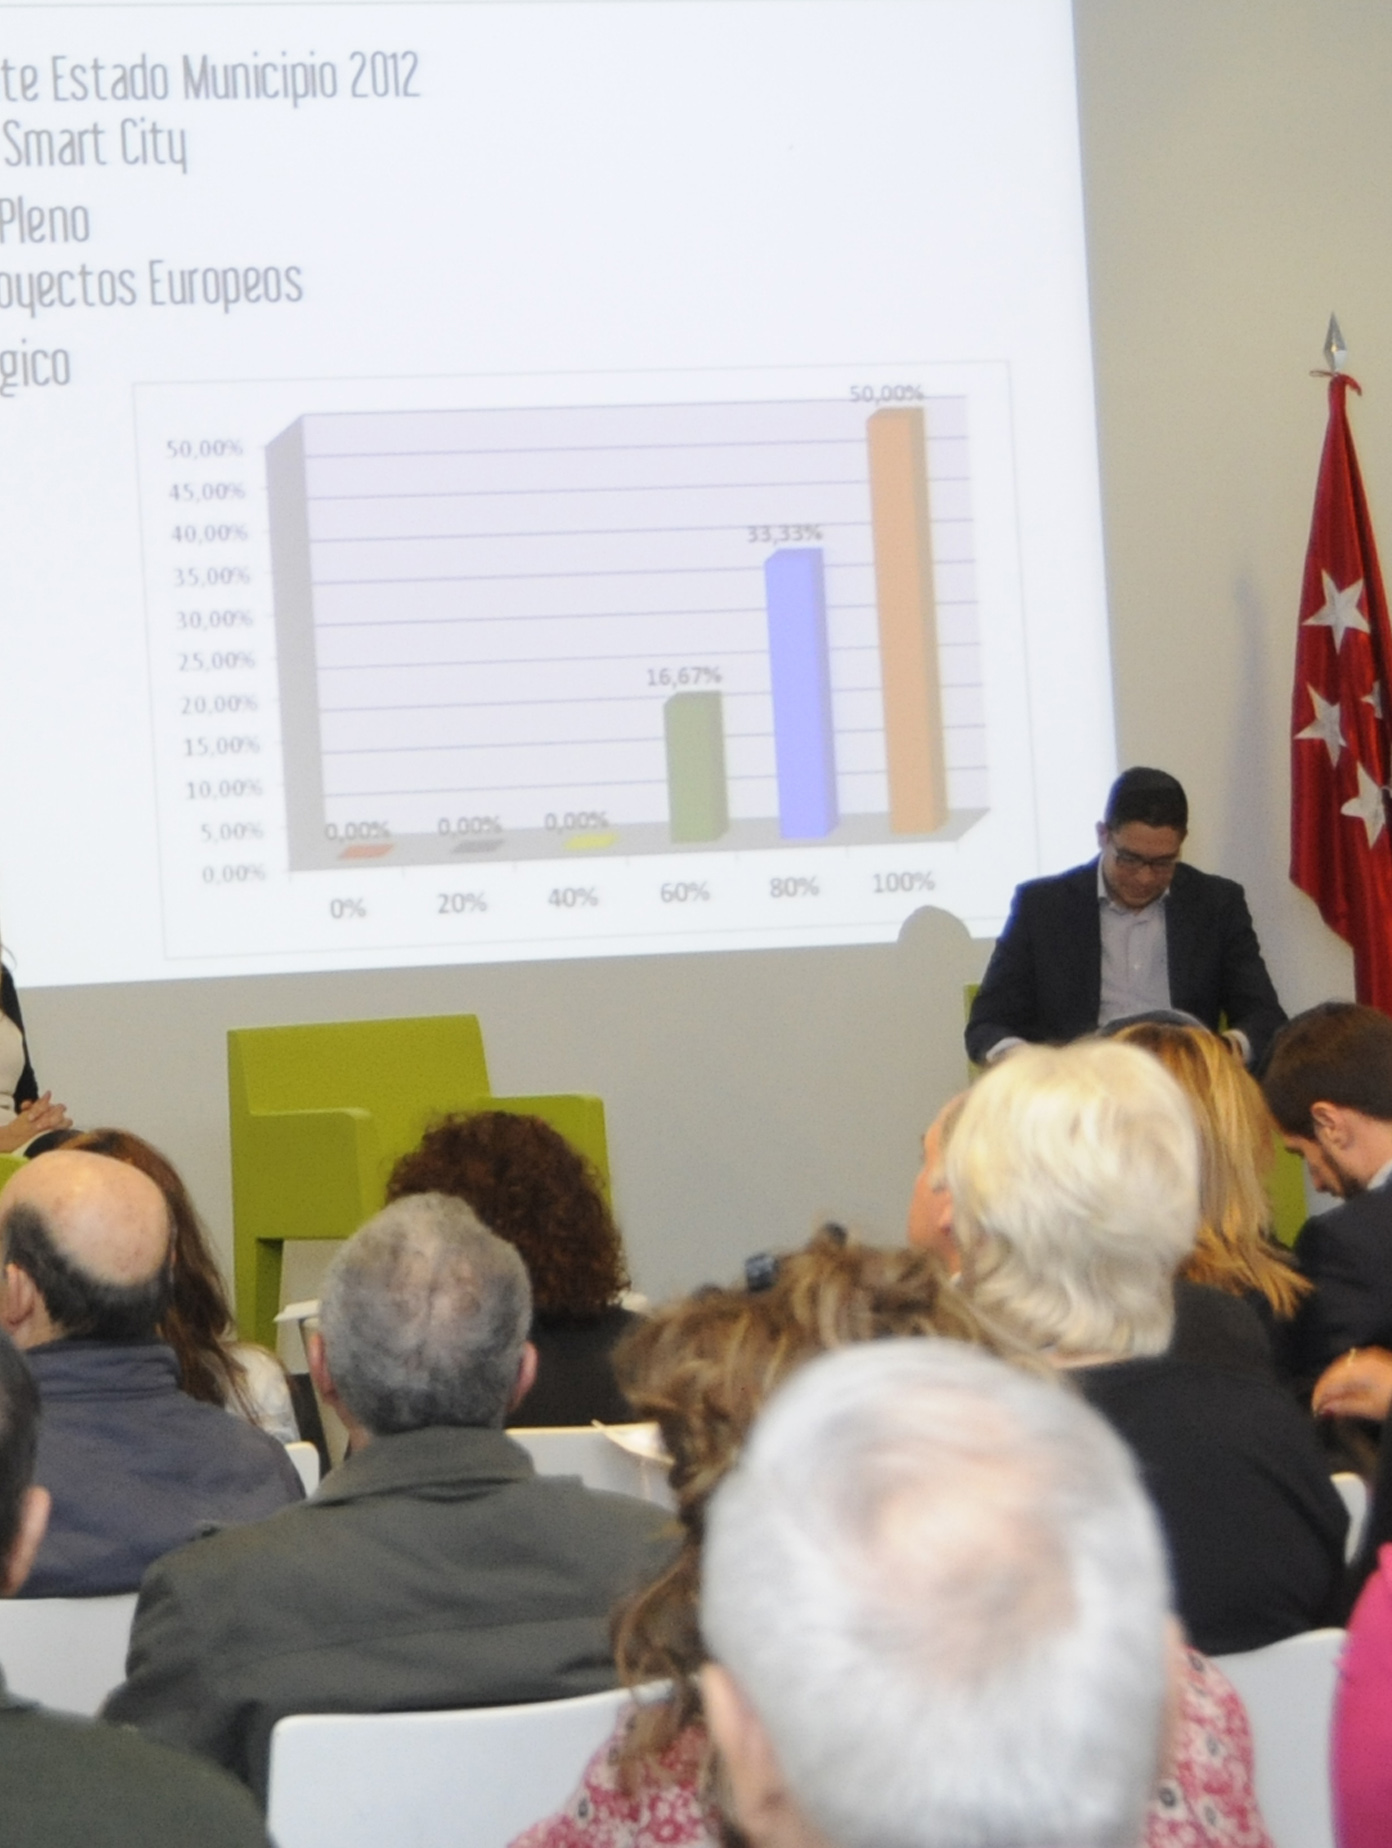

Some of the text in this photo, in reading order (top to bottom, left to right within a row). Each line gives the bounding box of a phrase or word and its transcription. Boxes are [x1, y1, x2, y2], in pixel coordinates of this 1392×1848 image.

[52, 52, 170, 102] Estado
[182, 50, 338, 109] Municipio
[350, 50, 421, 99] 2012
[2, 119, 108, 168] Smart
[120, 116, 188, 174] City
[148, 259, 304, 314] Europeos
[849, 385, 925, 405] 50,00%
[166, 438, 244, 460] 50,00%
[169, 481, 246, 503] 45,00%
[171, 524, 249, 545] 40,00%
[747, 524, 824, 544] 33,33%
[174, 566, 251, 588] 35,00%
[176, 610, 253, 631] 30,00%
[178, 652, 256, 673] 25,00%
[648, 667, 723, 688] 16,67%
[181, 695, 259, 716] 20,00%
[184, 736, 261, 758] 15,00%
[186, 779, 264, 801] 10,00%
[201, 822, 264, 844] 5,00%
[325, 811, 609, 843] 0,00% 0,00% 0,00%
[202, 864, 266, 885] 0,00%
[330, 871, 936, 919] 0% 20% 40% 60% 80% 100%
